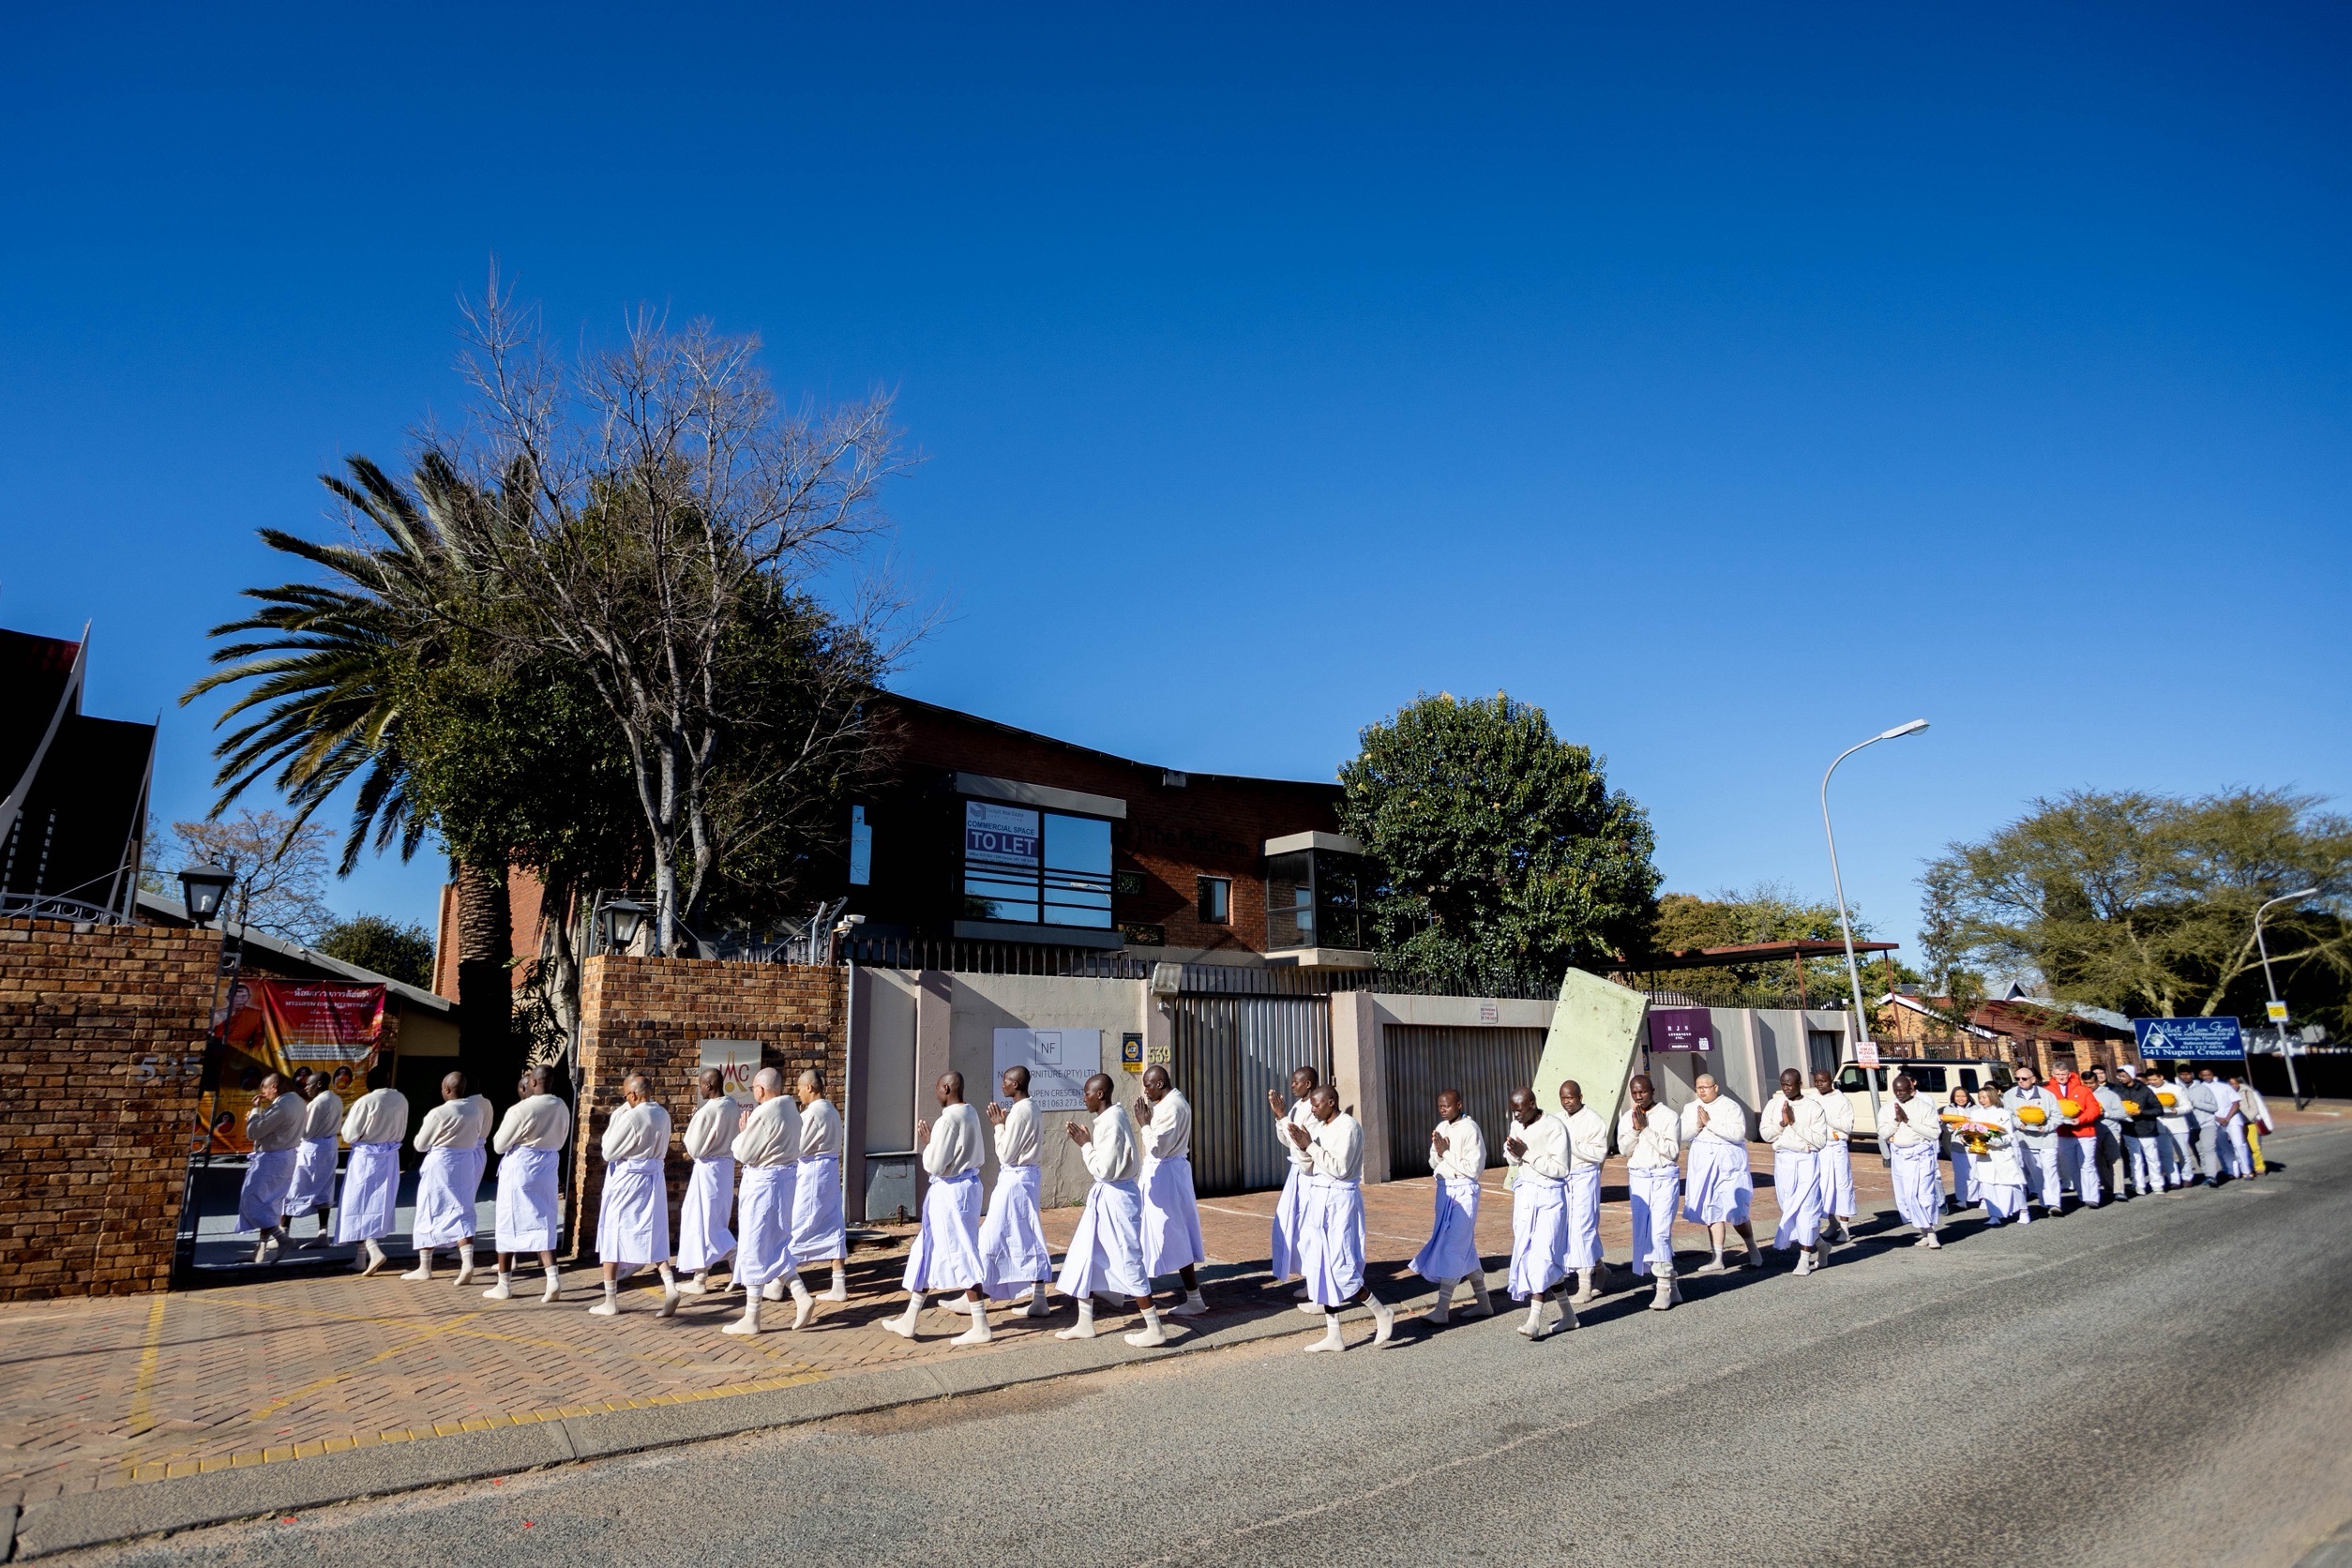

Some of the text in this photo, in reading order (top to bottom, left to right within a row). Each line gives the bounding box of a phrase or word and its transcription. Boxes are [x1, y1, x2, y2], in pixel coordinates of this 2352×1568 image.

[967, 820, 1035, 836] COMMERCIAL SPACE
[972, 831, 1035, 855] TO LET
[1180, 826, 1248, 857] Platform
[2184, 1021, 2209, 1033] Moon
[1041, 1042, 1056, 1054] NF
[1147, 1045, 1171, 1063] 539
[2196, 1048, 2242, 1056] Crescent
[135, 1056, 201, 1081] 535
[1030, 1069, 1097, 1079] RNITURE (PTY) LTD
[1030, 1088, 1085, 1098] UPEN CRESCENT
[1050, 1099, 1063, 1108] 063
[1064, 1098, 1078, 1107] 273
